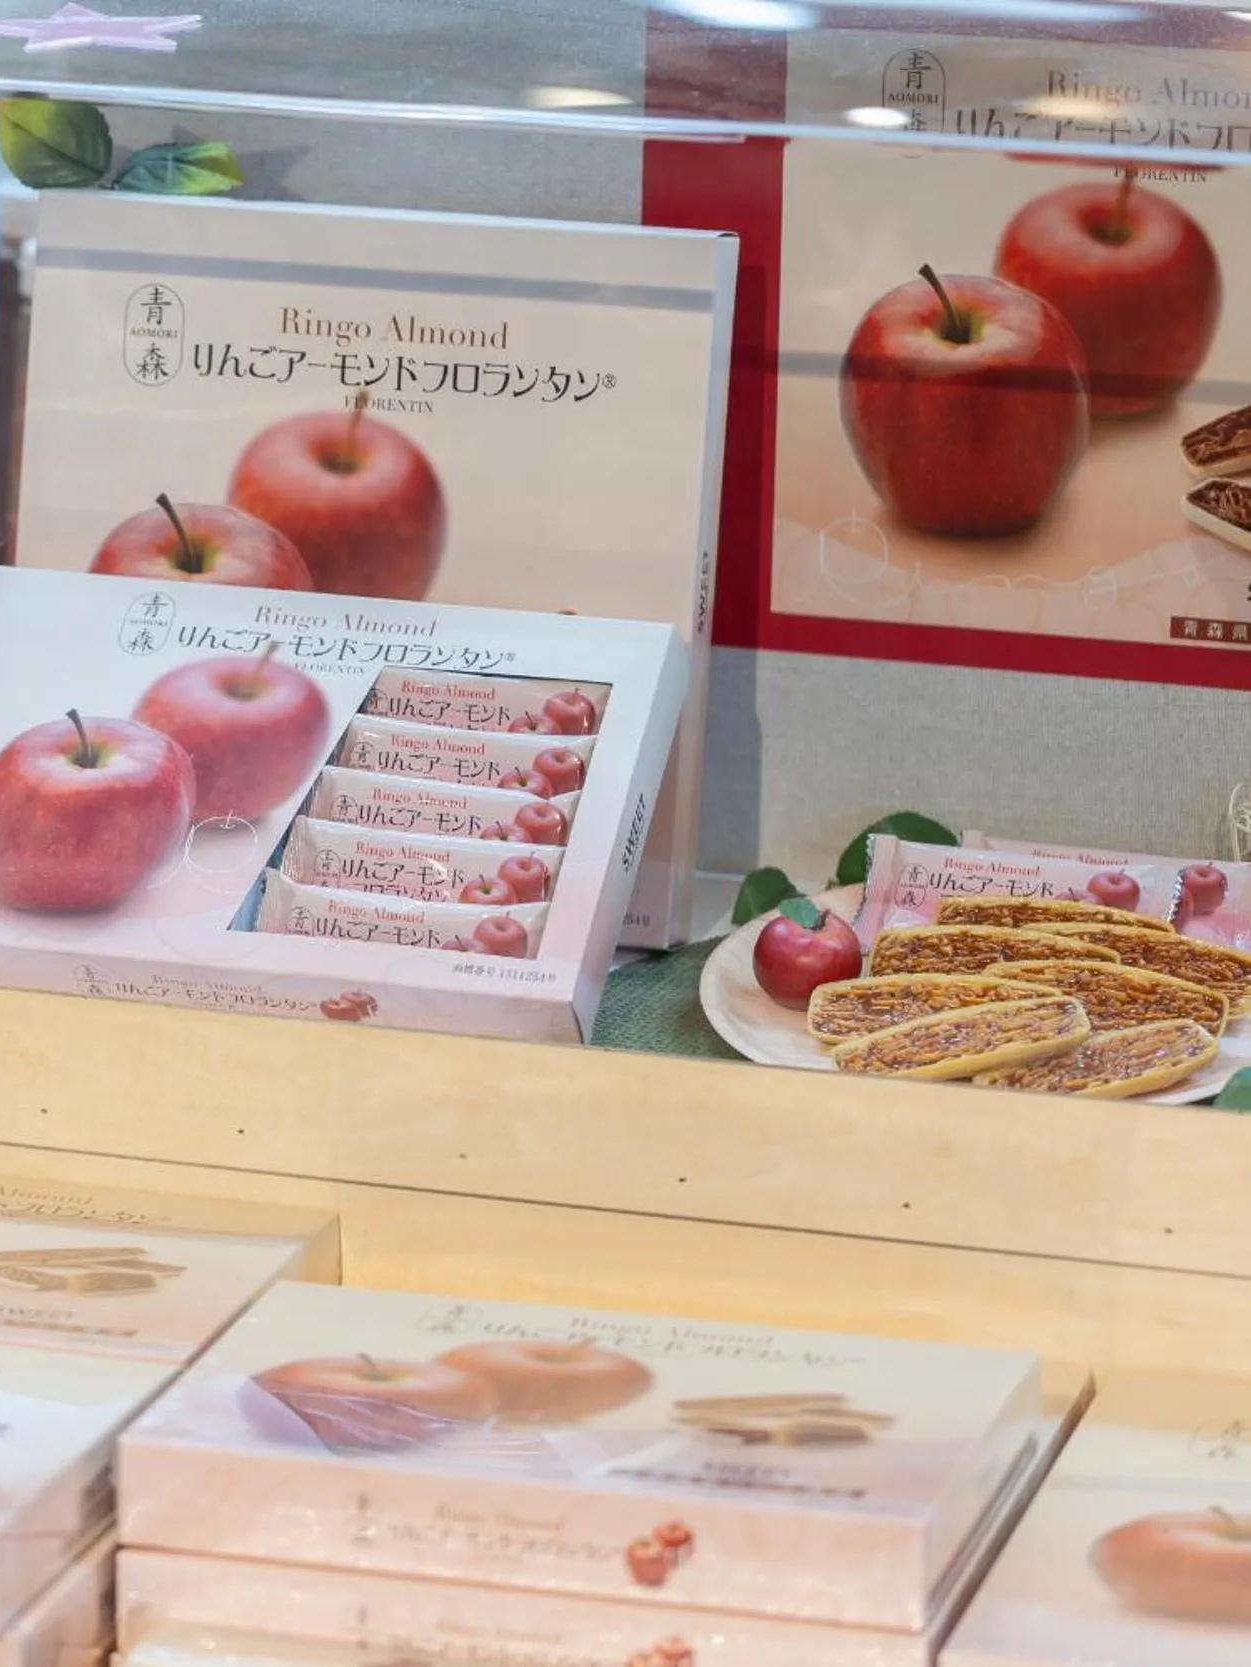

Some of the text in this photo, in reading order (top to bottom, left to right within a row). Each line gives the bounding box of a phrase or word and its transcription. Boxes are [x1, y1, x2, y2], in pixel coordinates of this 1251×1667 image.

[888, 92, 939, 105] AOMORI
[1049, 69, 1142, 107] Ringo
[141, 287, 173, 325] 青
[129, 326, 179, 339] AOMORI
[280, 306, 508, 349] Ringo Almond
[136, 342, 169, 381] 森
[254, 606, 438, 638] Ringo Almond
[401, 680, 440, 697] Ringo
[388, 698, 511, 726] りんごアーモンド
[391, 734, 430, 750] Ringo
[377, 751, 500, 780] りんごアーモンド
[372, 788, 411, 803] Ringo
[358, 804, 481, 834] りんごアーモンド
[355, 842, 394, 858] Ringo
[341, 859, 468, 887] りんごアーモンド
[944, 857, 1041, 877] Ringo Almond
[929, 872, 1054, 899] りんごアーモンド
[328, 900, 367, 917] Ringo
[315, 918, 440, 947] りんごアーモンド
